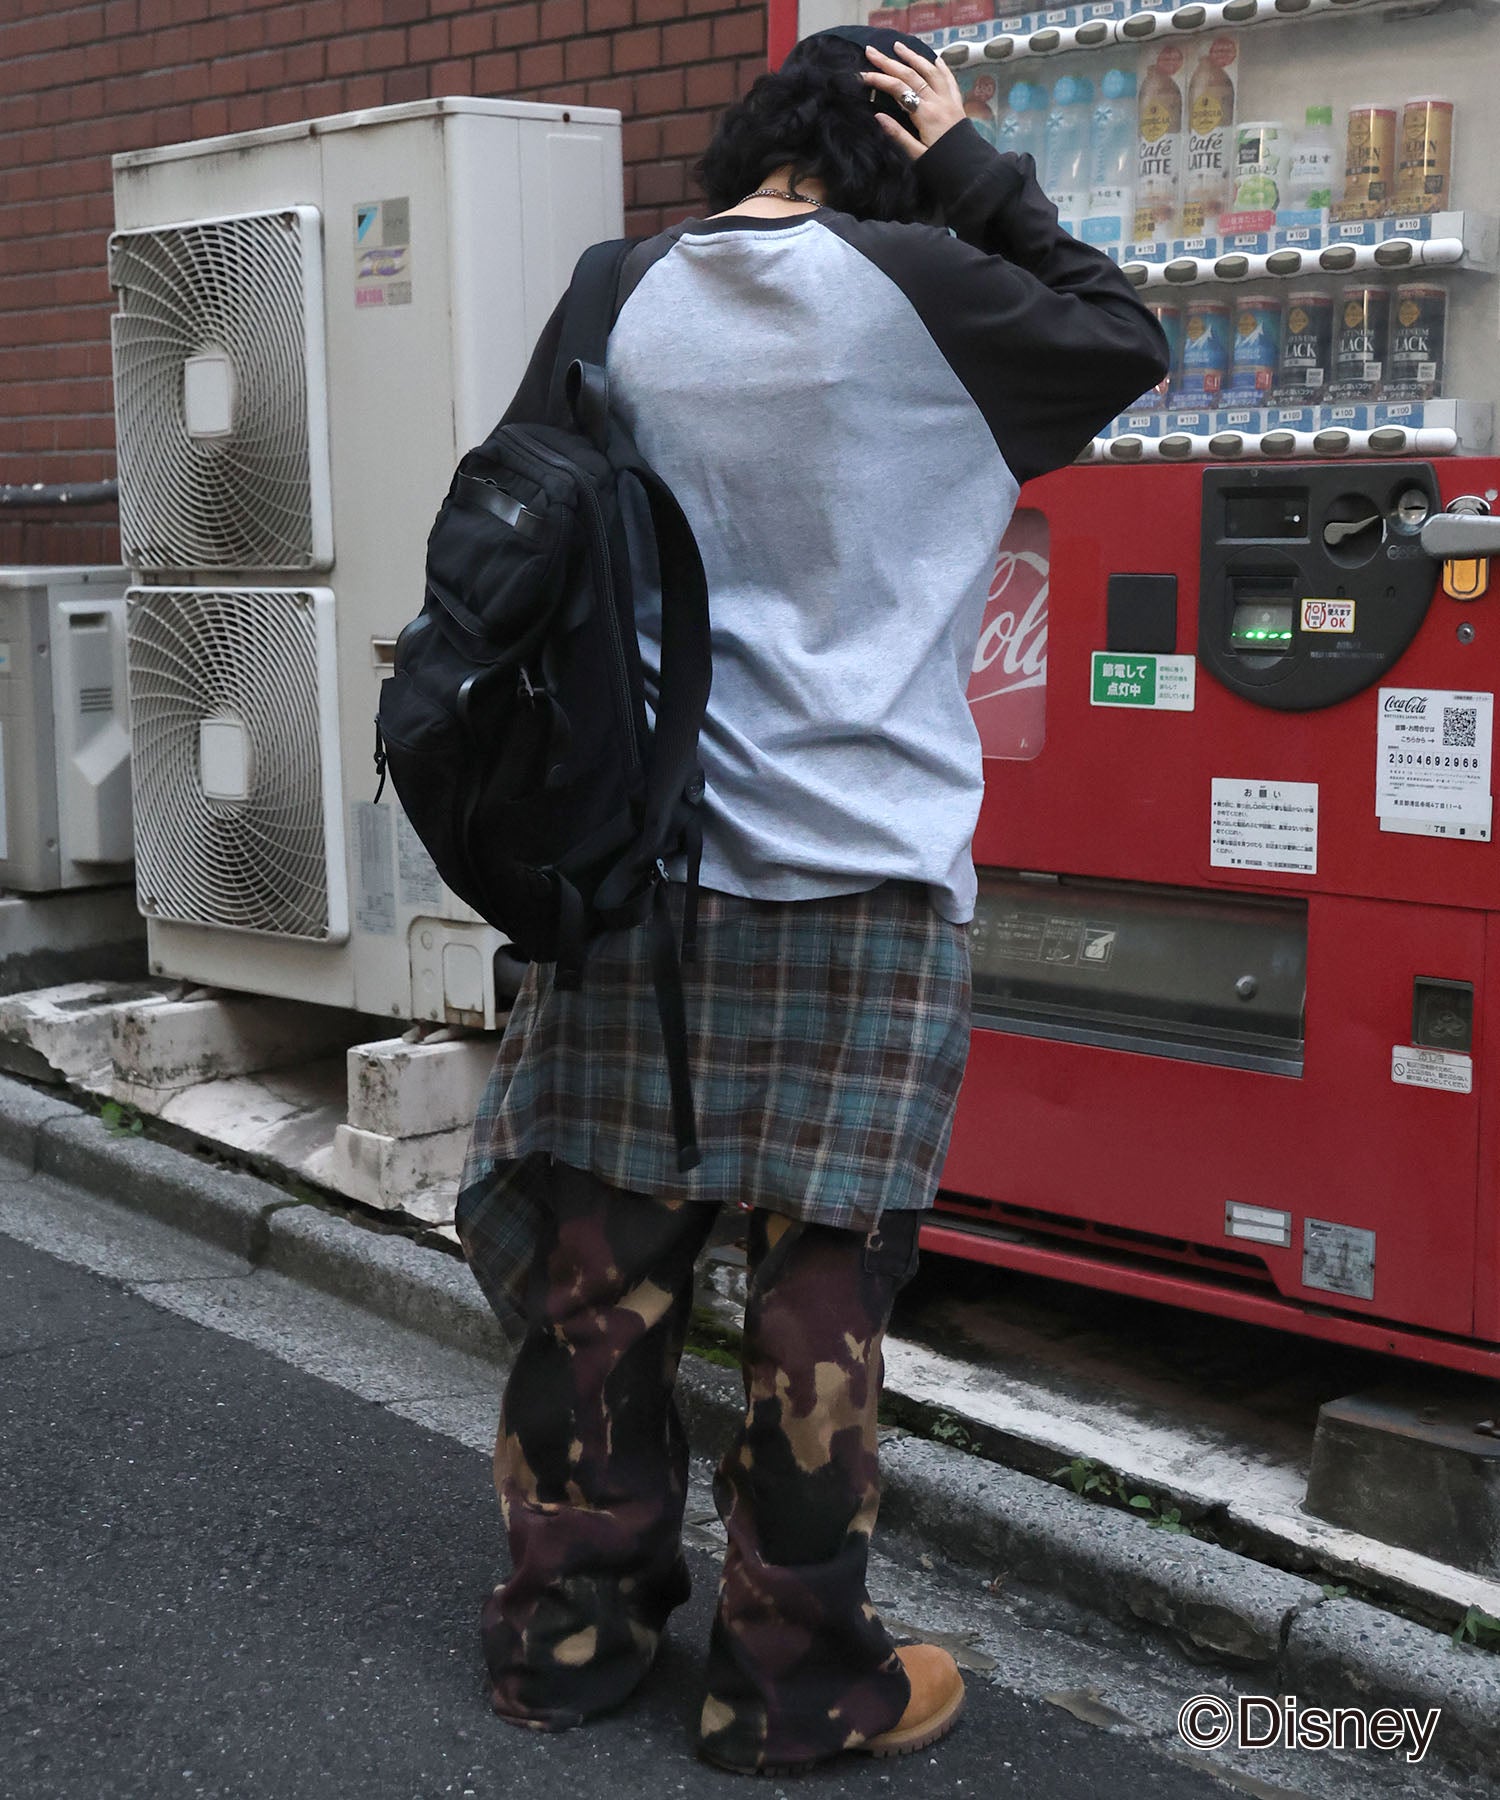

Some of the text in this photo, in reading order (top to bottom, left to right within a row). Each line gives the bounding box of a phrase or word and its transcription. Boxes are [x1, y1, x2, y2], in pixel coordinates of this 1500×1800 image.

[1398, 220, 1418, 229] ¥110
[1335, 409, 1354, 417] ¥100
[1390, 406, 1410, 415] ¥100
[1330, 617, 1346, 628] OK
[1102, 662, 1147, 679] 節電して
[1107, 681, 1141, 697] 点灯中
[1388, 753, 1478, 769] 2304692968
